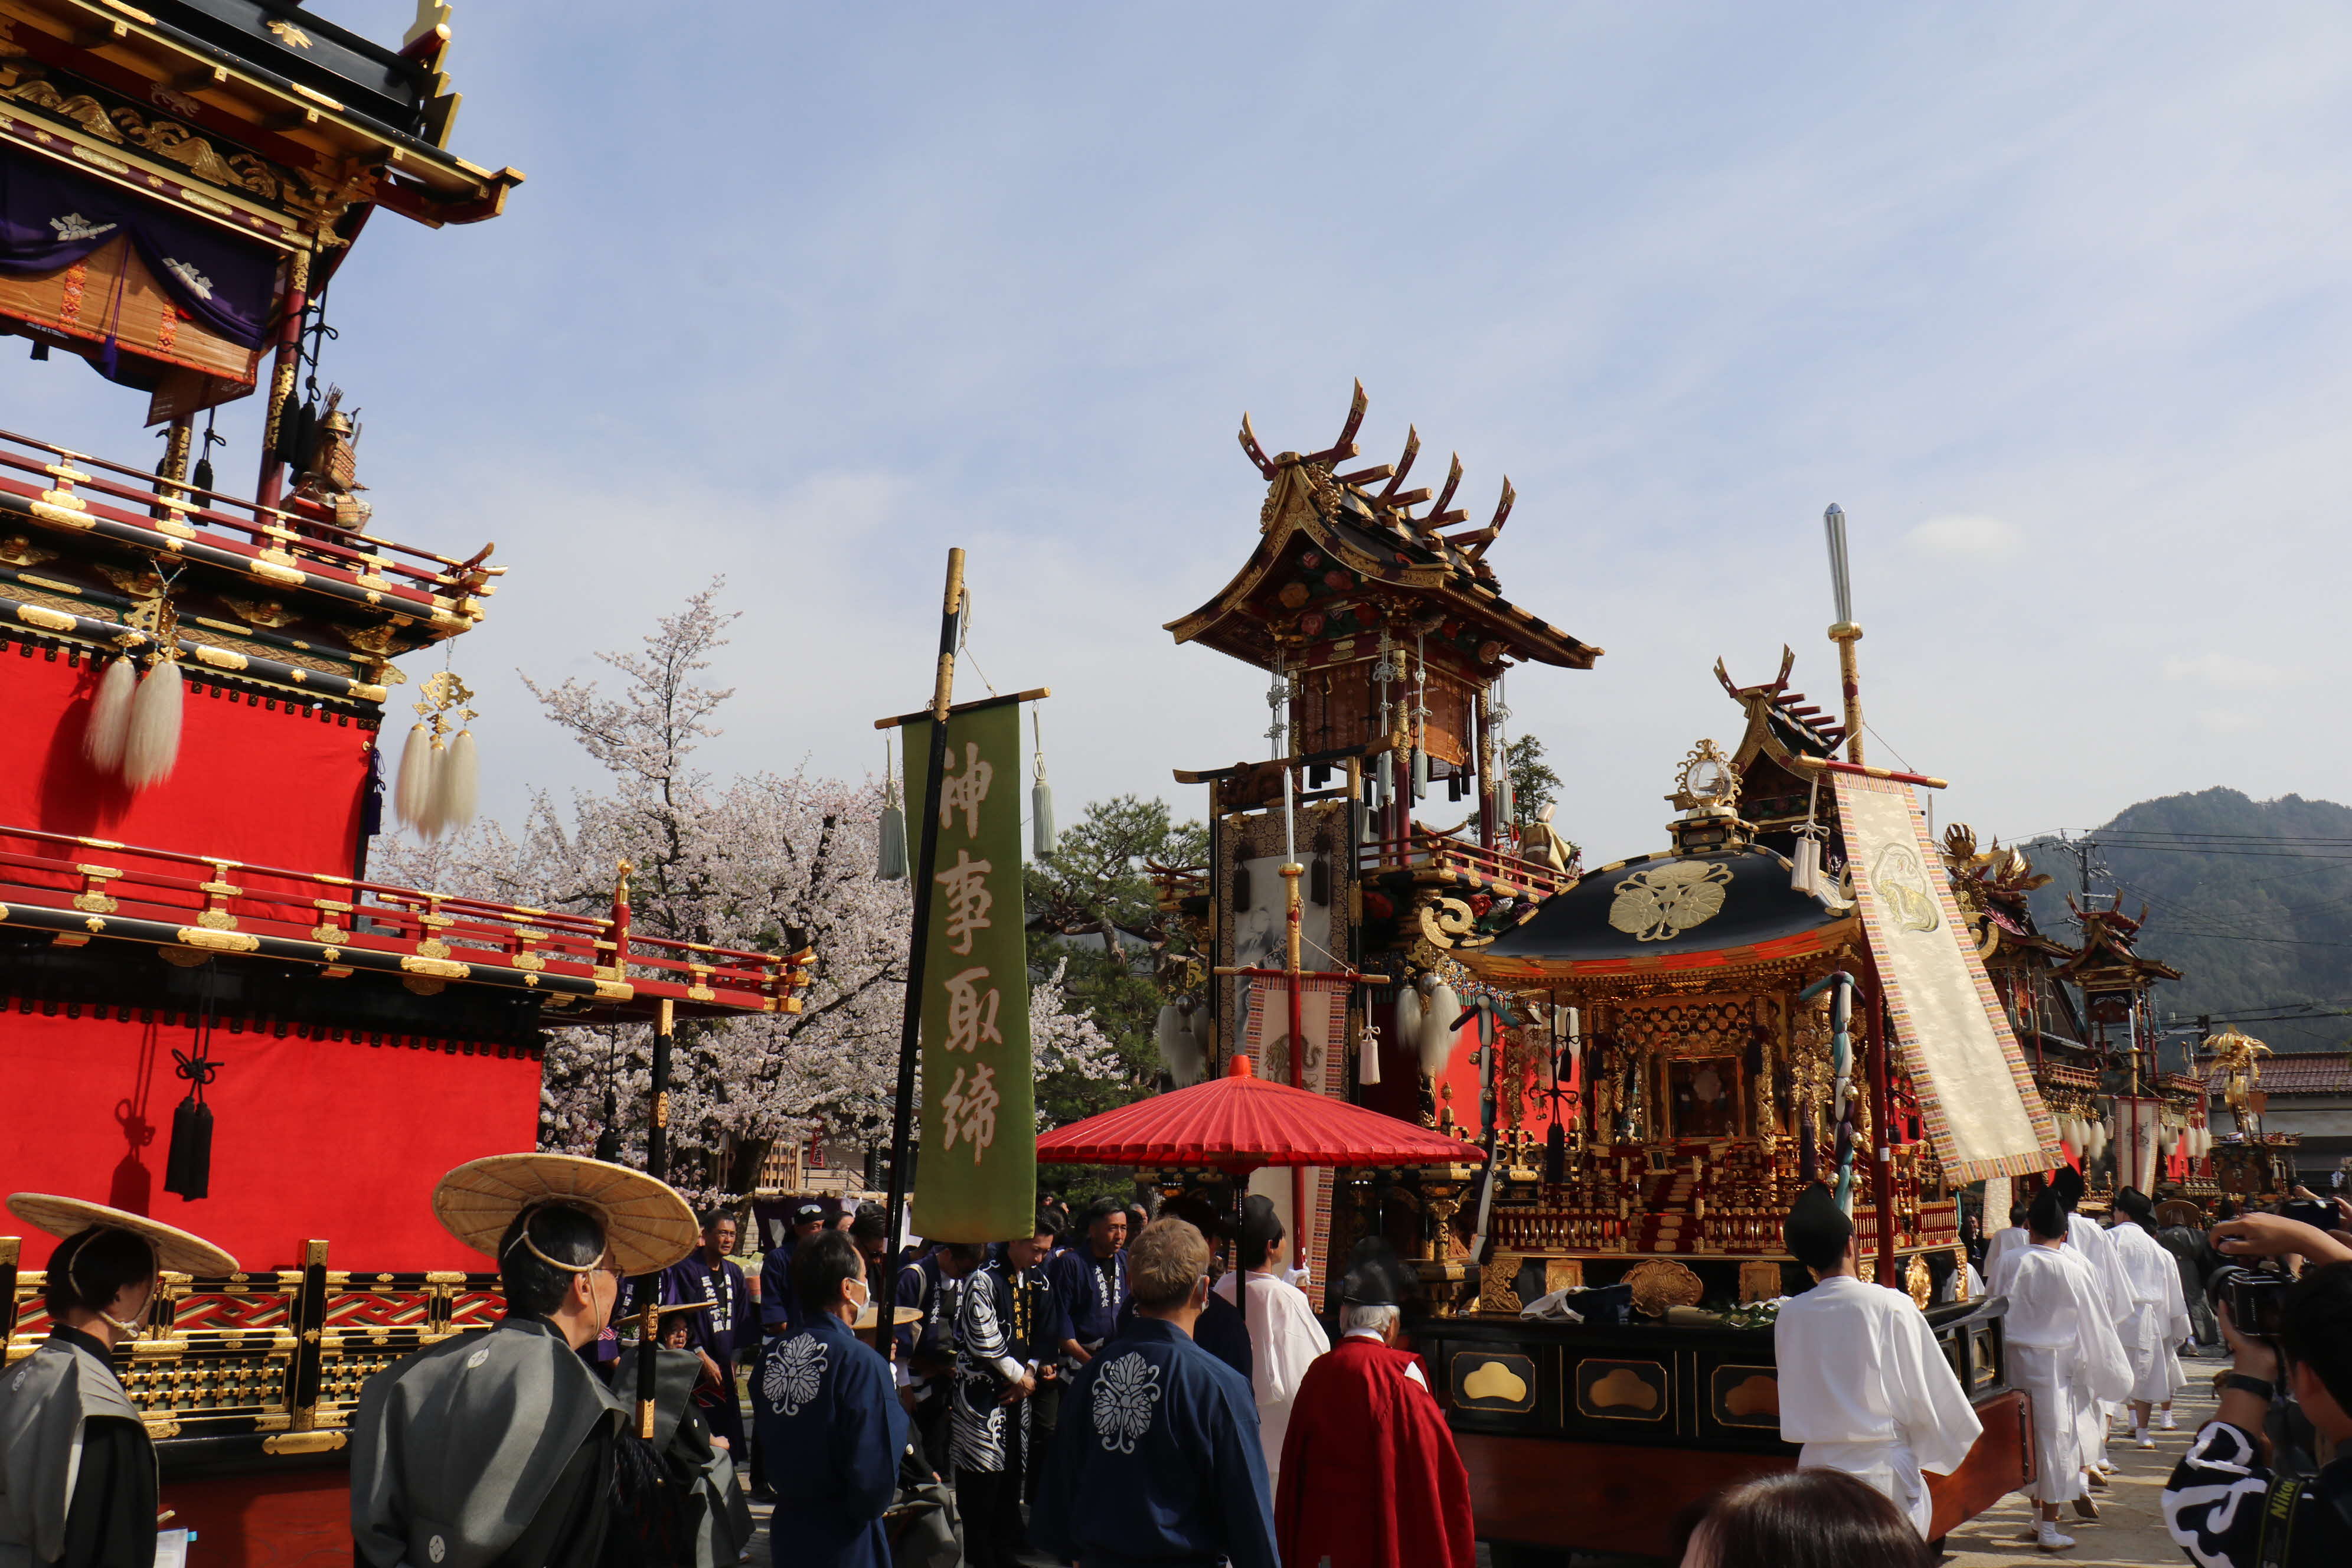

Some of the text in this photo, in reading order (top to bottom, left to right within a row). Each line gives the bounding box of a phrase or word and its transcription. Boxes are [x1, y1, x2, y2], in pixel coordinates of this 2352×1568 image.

[935, 741, 1004, 1165] 神事取締
[2269, 1481, 2296, 1520] Nikon
